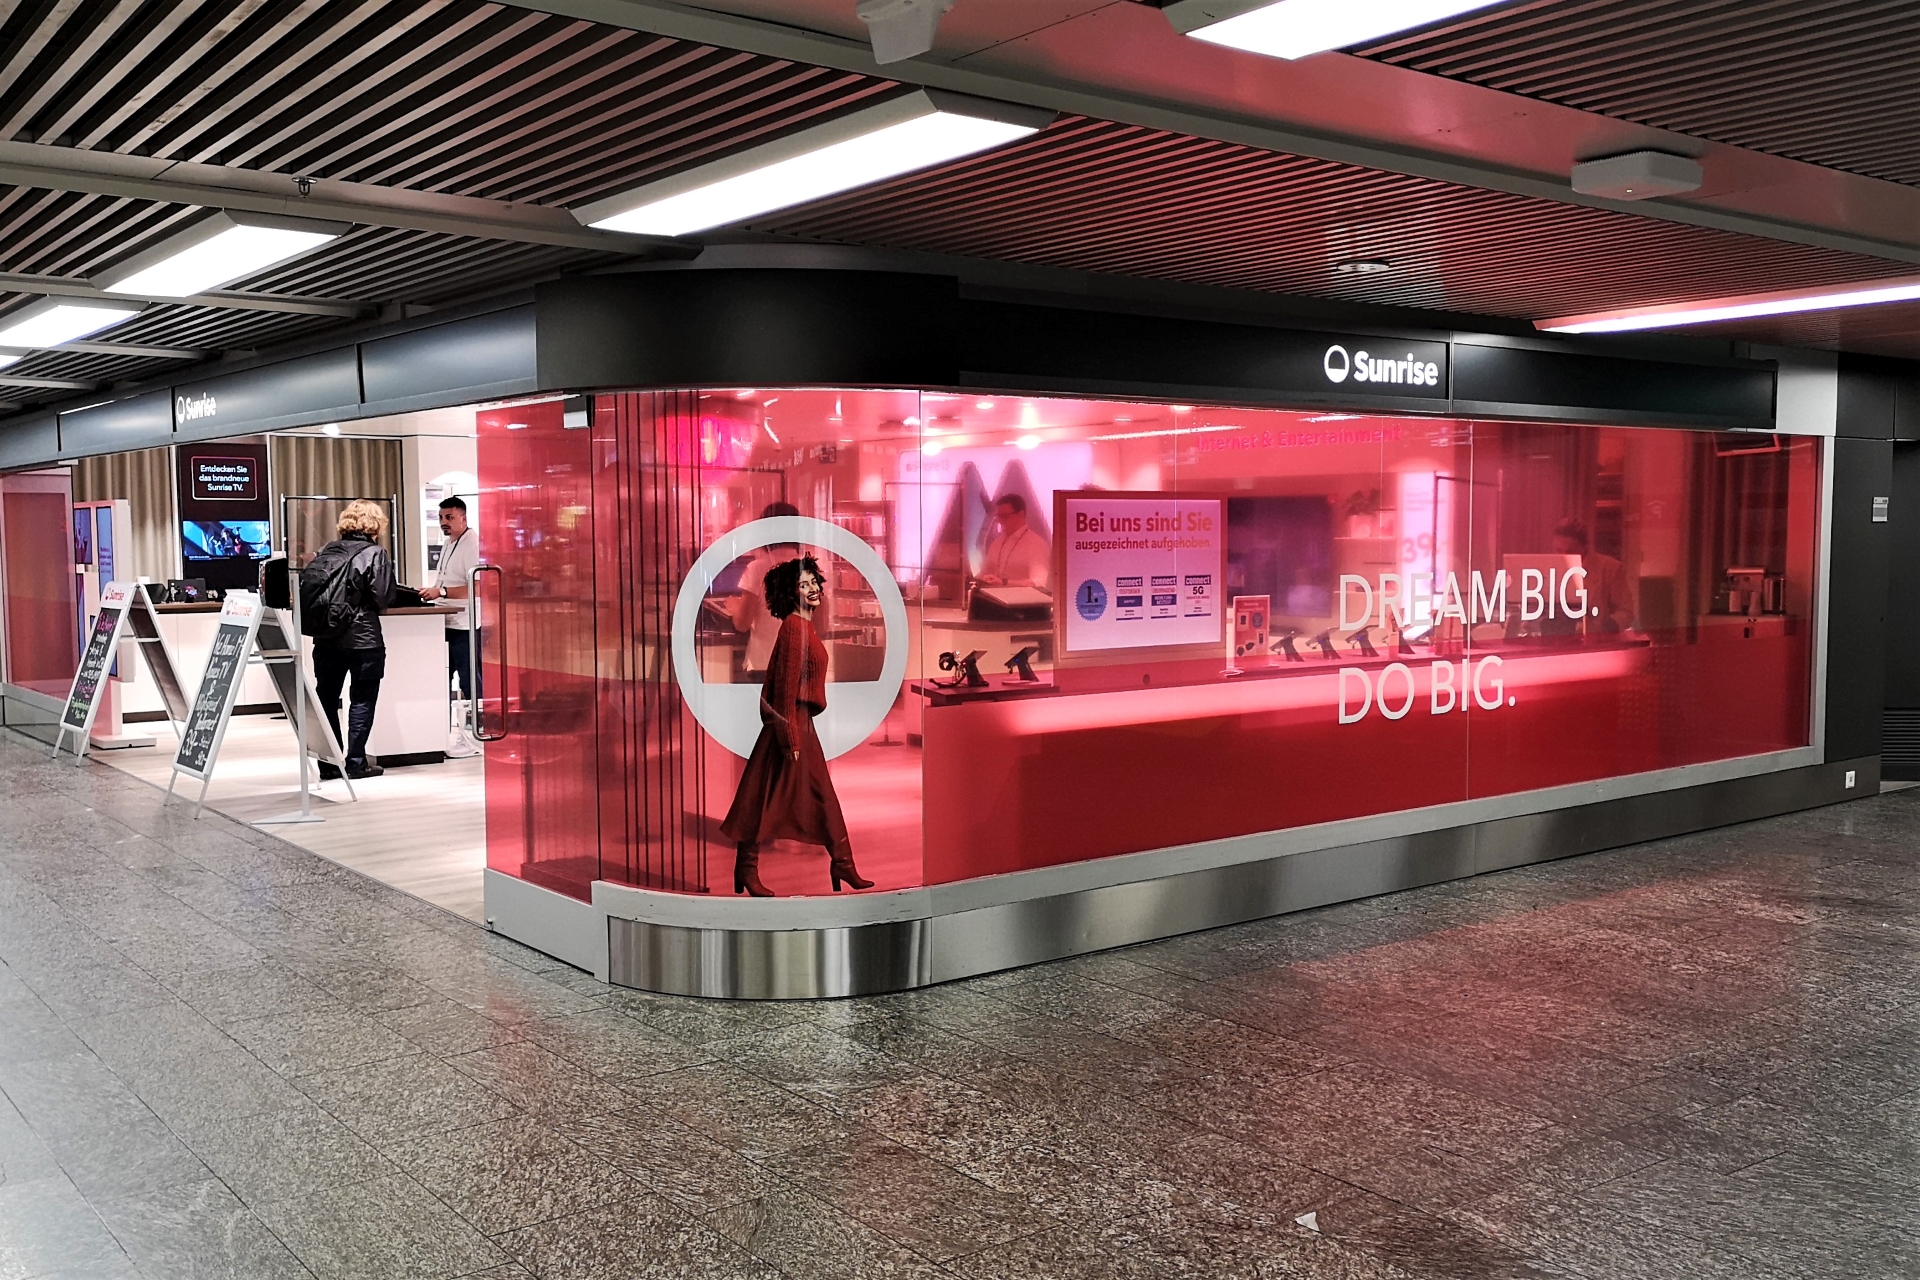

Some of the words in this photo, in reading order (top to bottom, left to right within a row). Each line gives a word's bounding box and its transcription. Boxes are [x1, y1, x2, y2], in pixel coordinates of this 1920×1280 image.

[1353, 350, 1439, 386] Sunrise
[185, 391, 217, 421] Sunrise
[1197, 433, 1258, 452] Internet
[1262, 430, 1274, 448] &
[1278, 424, 1402, 448] Entertainment
[200, 464, 236, 473] Entdecken
[236, 465, 248, 473] Sie
[198, 474, 212, 482] das
[212, 474, 250, 482] brandneue
[207, 483, 233, 491] Sunrise
[1075, 511, 1105, 533] Bei
[1110, 517, 1142, 532] uns
[1145, 511, 1182, 532] sind
[1187, 511, 1212, 532] Sie
[1075, 537, 1149, 552] ausgezeichnet
[1151, 536, 1212, 551] aufgehoben.
[1117, 578, 1142, 587] connect
[1152, 576, 1176, 585] connect
[1185, 576, 1211, 585] connect
[108, 589, 125, 601] Sunrise
[1085, 585, 1099, 604] 1.
[1192, 586, 1204, 595] 5G
[1339, 569, 1507, 631] DREAM
[1521, 566, 1600, 622] BIG.
[231, 602, 253, 617] Sunrise
[1338, 662, 1415, 724] DO
[1430, 655, 1516, 715] BIG.
